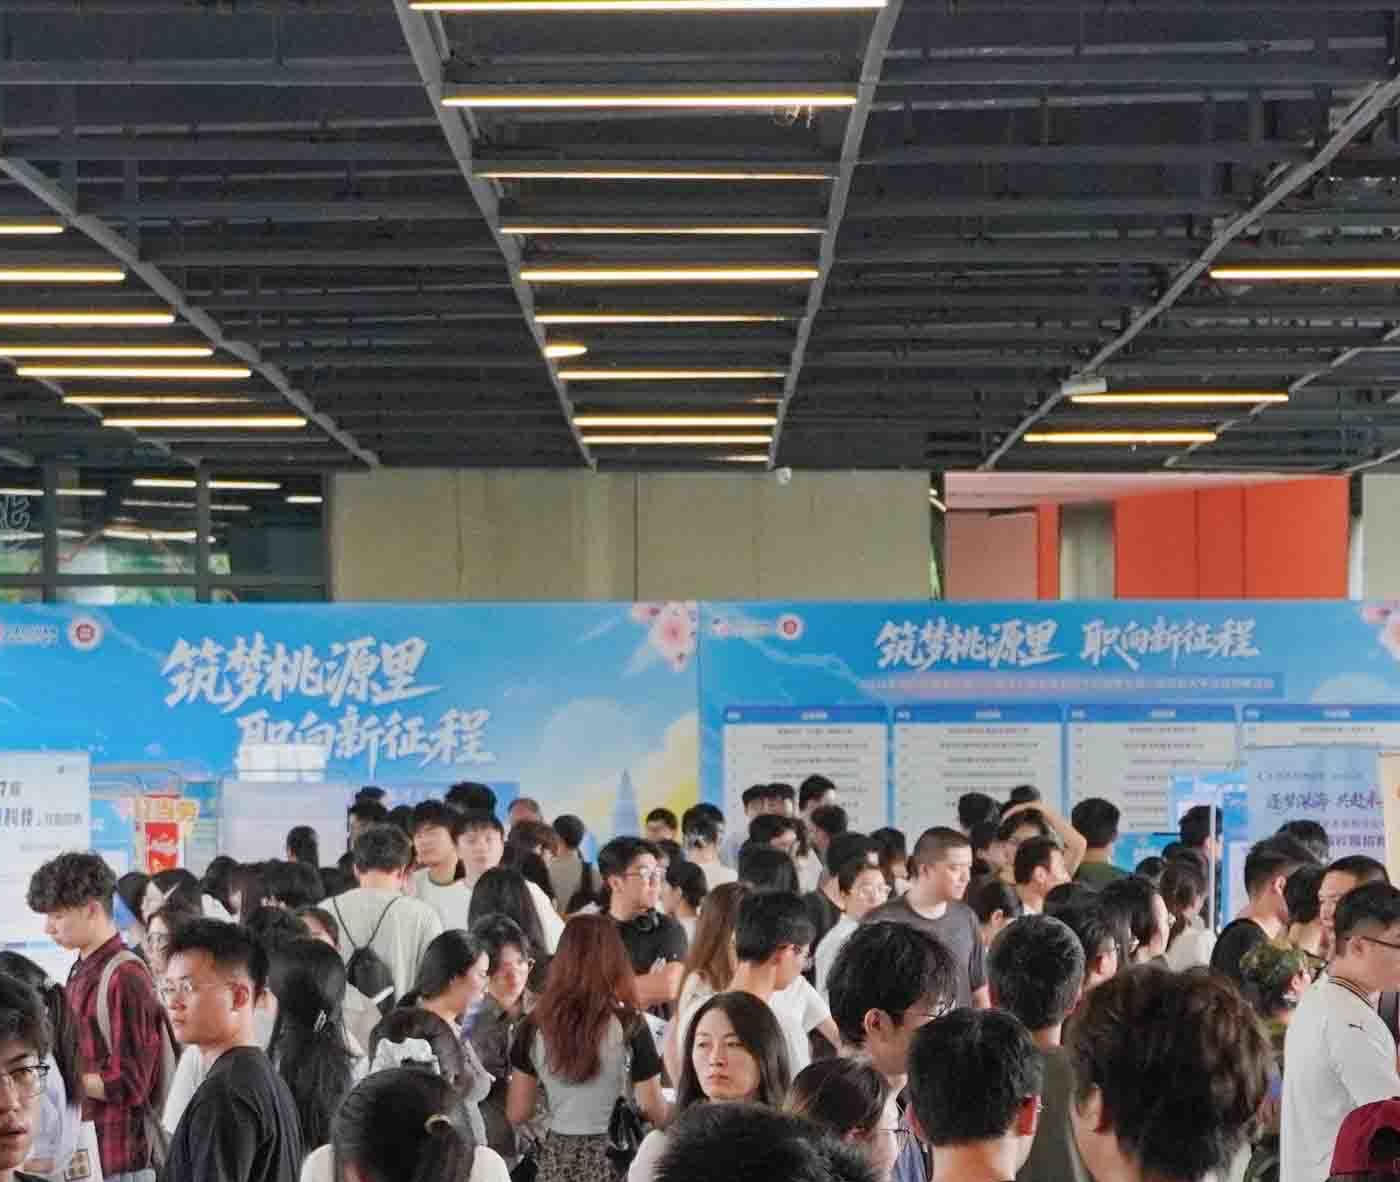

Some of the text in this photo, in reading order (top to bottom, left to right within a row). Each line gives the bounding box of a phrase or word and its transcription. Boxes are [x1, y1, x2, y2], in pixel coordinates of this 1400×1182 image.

[160, 631, 442, 713] 筑梦桃源里
[875, 614, 1260, 673] 筑梦桃源里 职向新征程
[234, 703, 498, 779] 职向新征程
